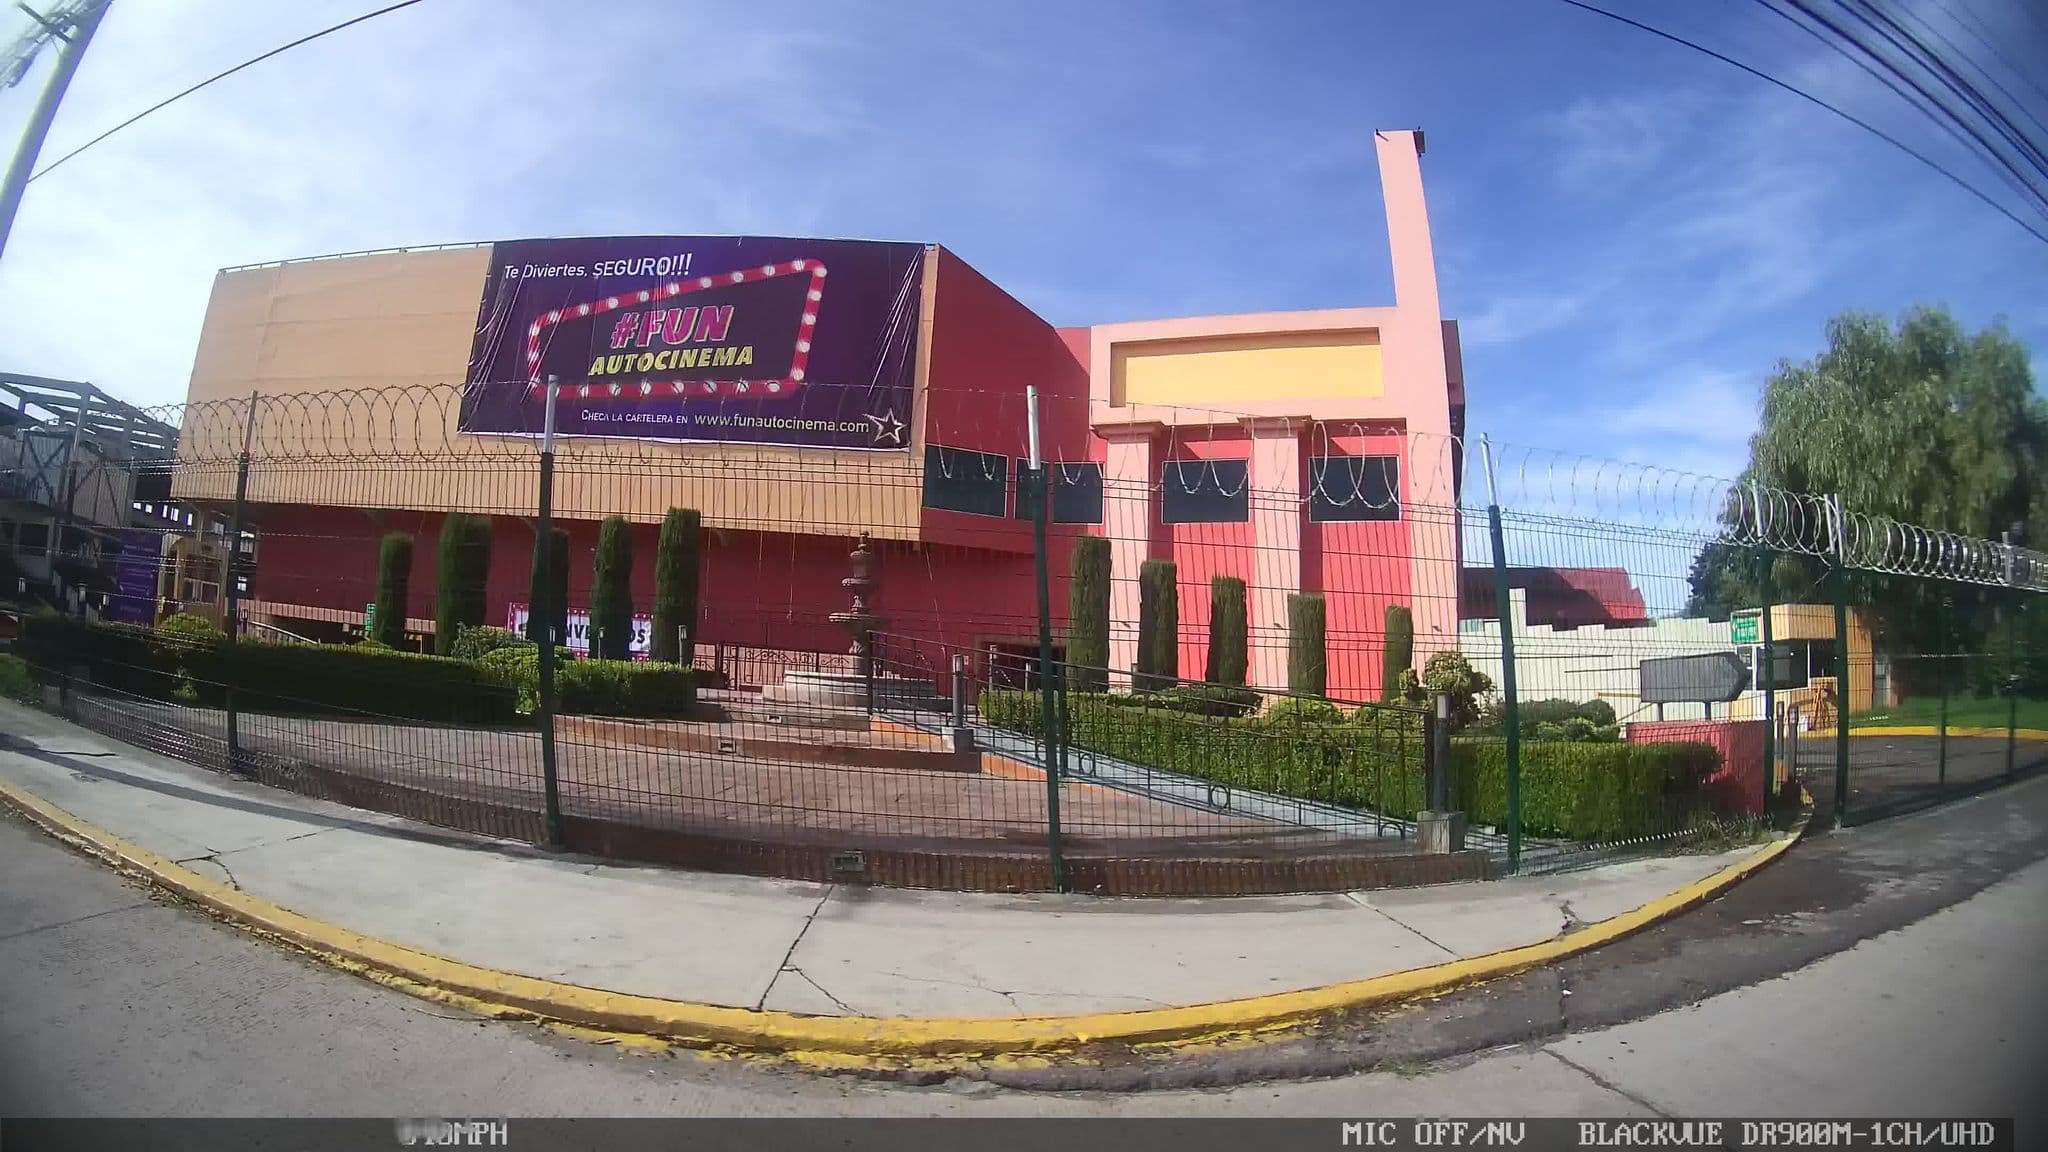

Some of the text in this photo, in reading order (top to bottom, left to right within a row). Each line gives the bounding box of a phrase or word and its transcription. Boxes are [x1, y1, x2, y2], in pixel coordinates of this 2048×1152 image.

[504, 253, 693, 279] Te Diviertes, SEGURO!!!
[610, 305, 735, 349] #FUN
[588, 345, 754, 376] AUTOCINEMA
[676, 415, 689, 424] EN
[694, 413, 870, 433] www.funautocinema.com
